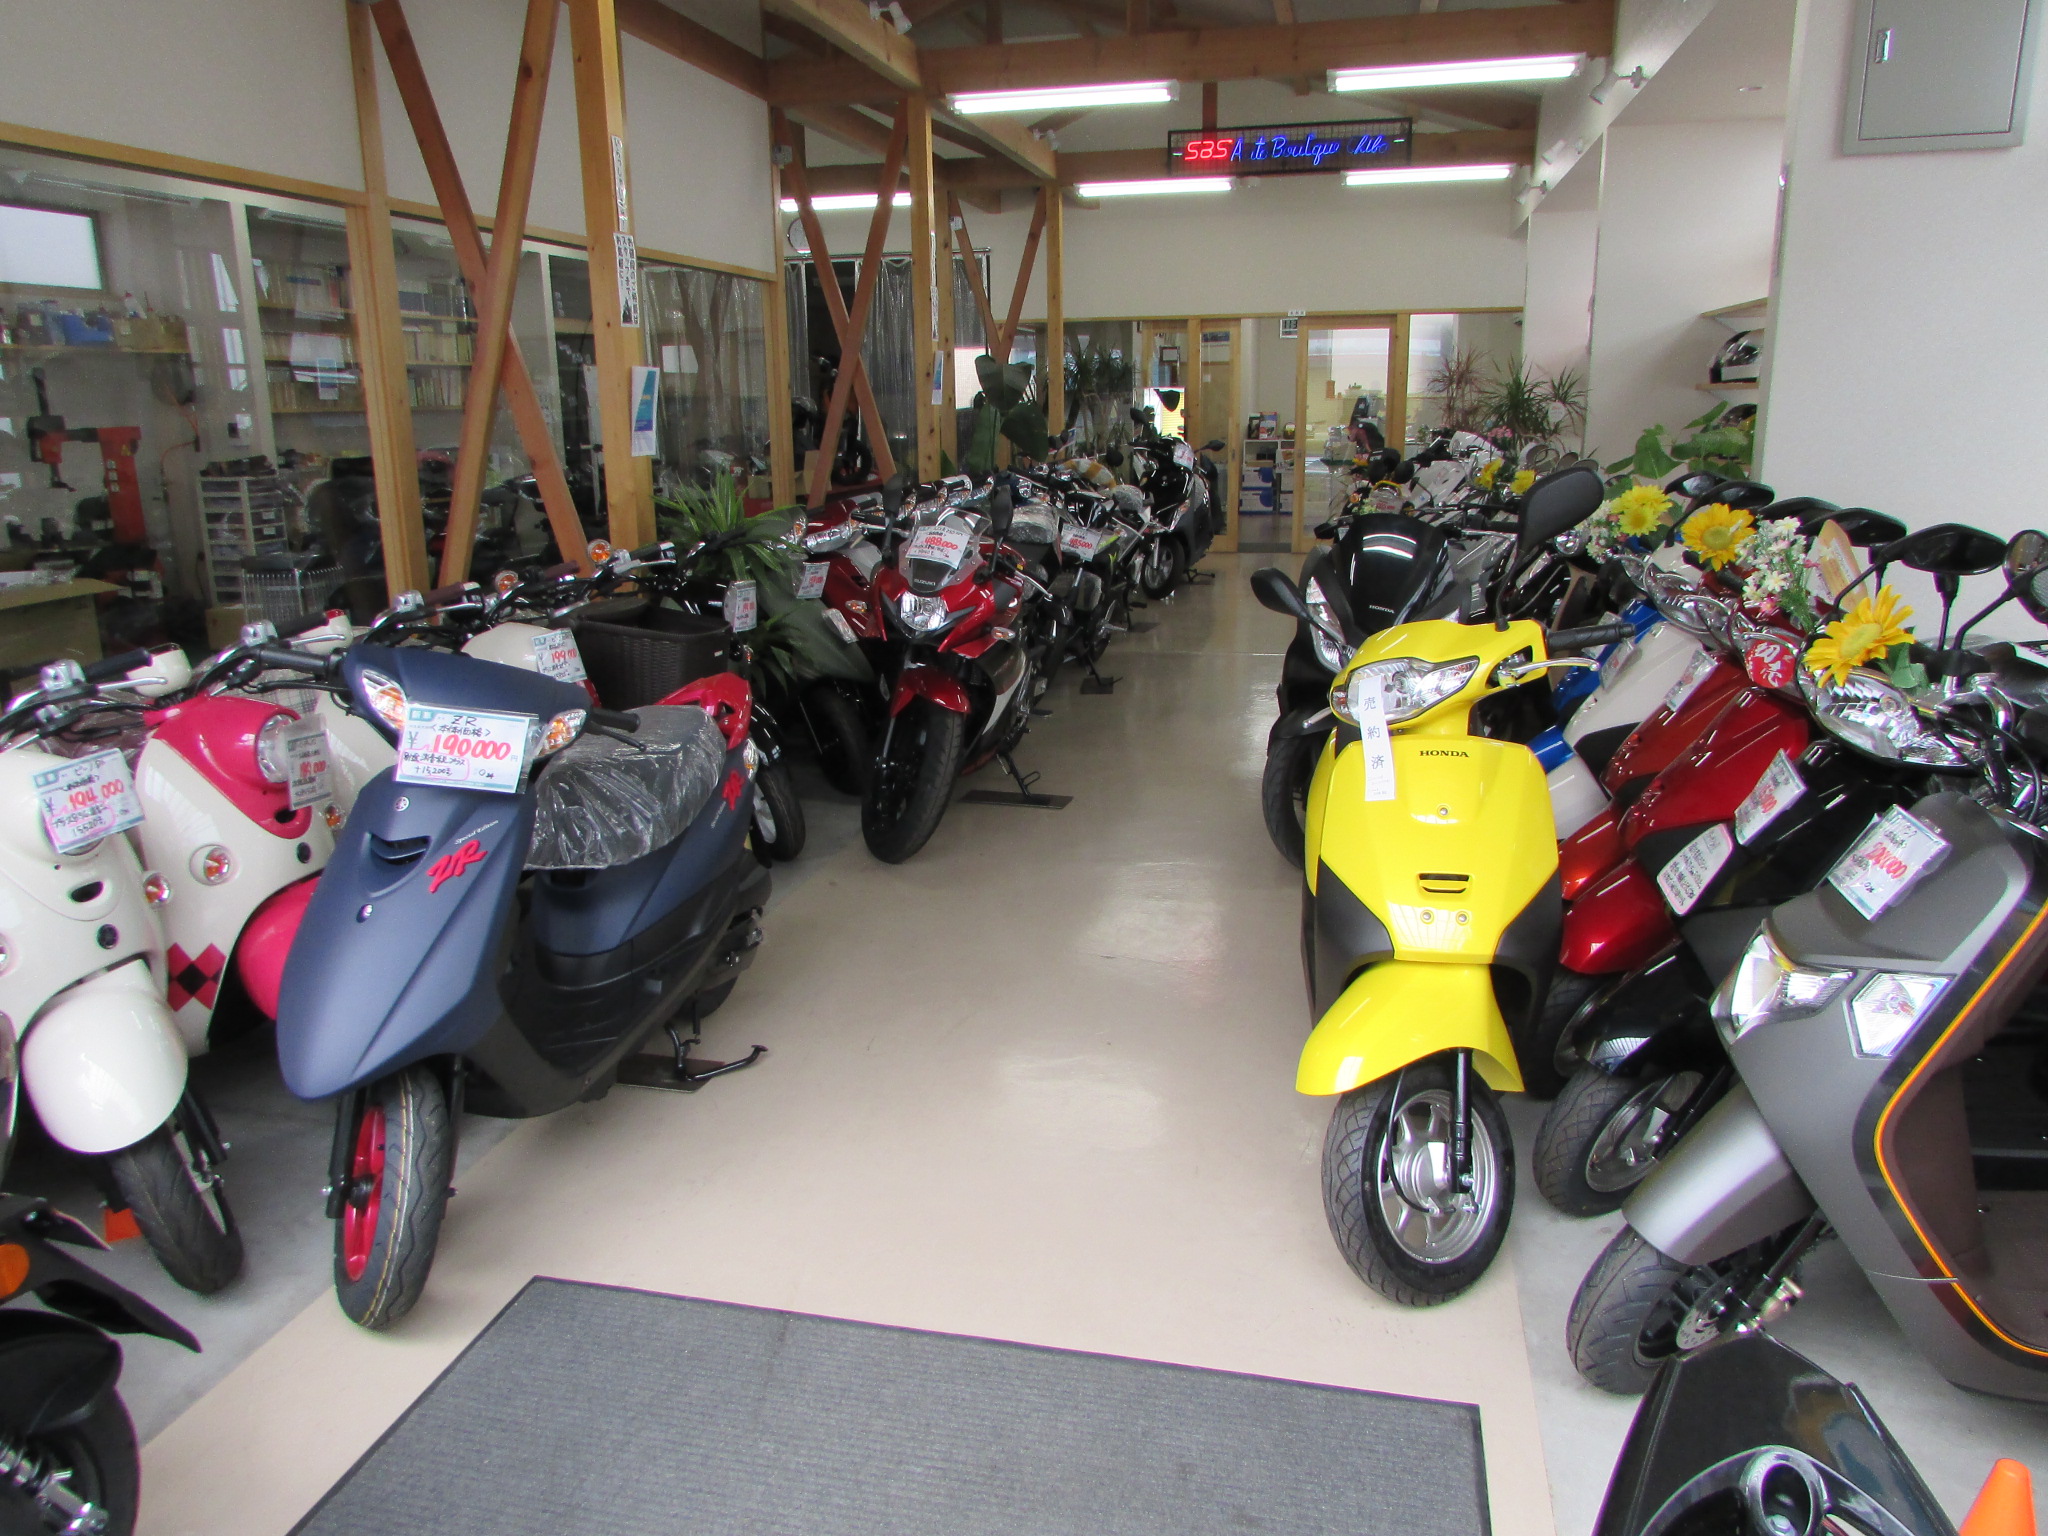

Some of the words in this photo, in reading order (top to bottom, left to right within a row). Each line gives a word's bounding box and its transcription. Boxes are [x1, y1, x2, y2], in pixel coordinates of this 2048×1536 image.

[1184, 139, 1233, 160] SBS
[1363, 696, 1385, 769] 売約済
[433, 734, 512, 761] 190000
[1419, 749, 1469, 758] HONDA
[426, 839, 489, 894] ZR
